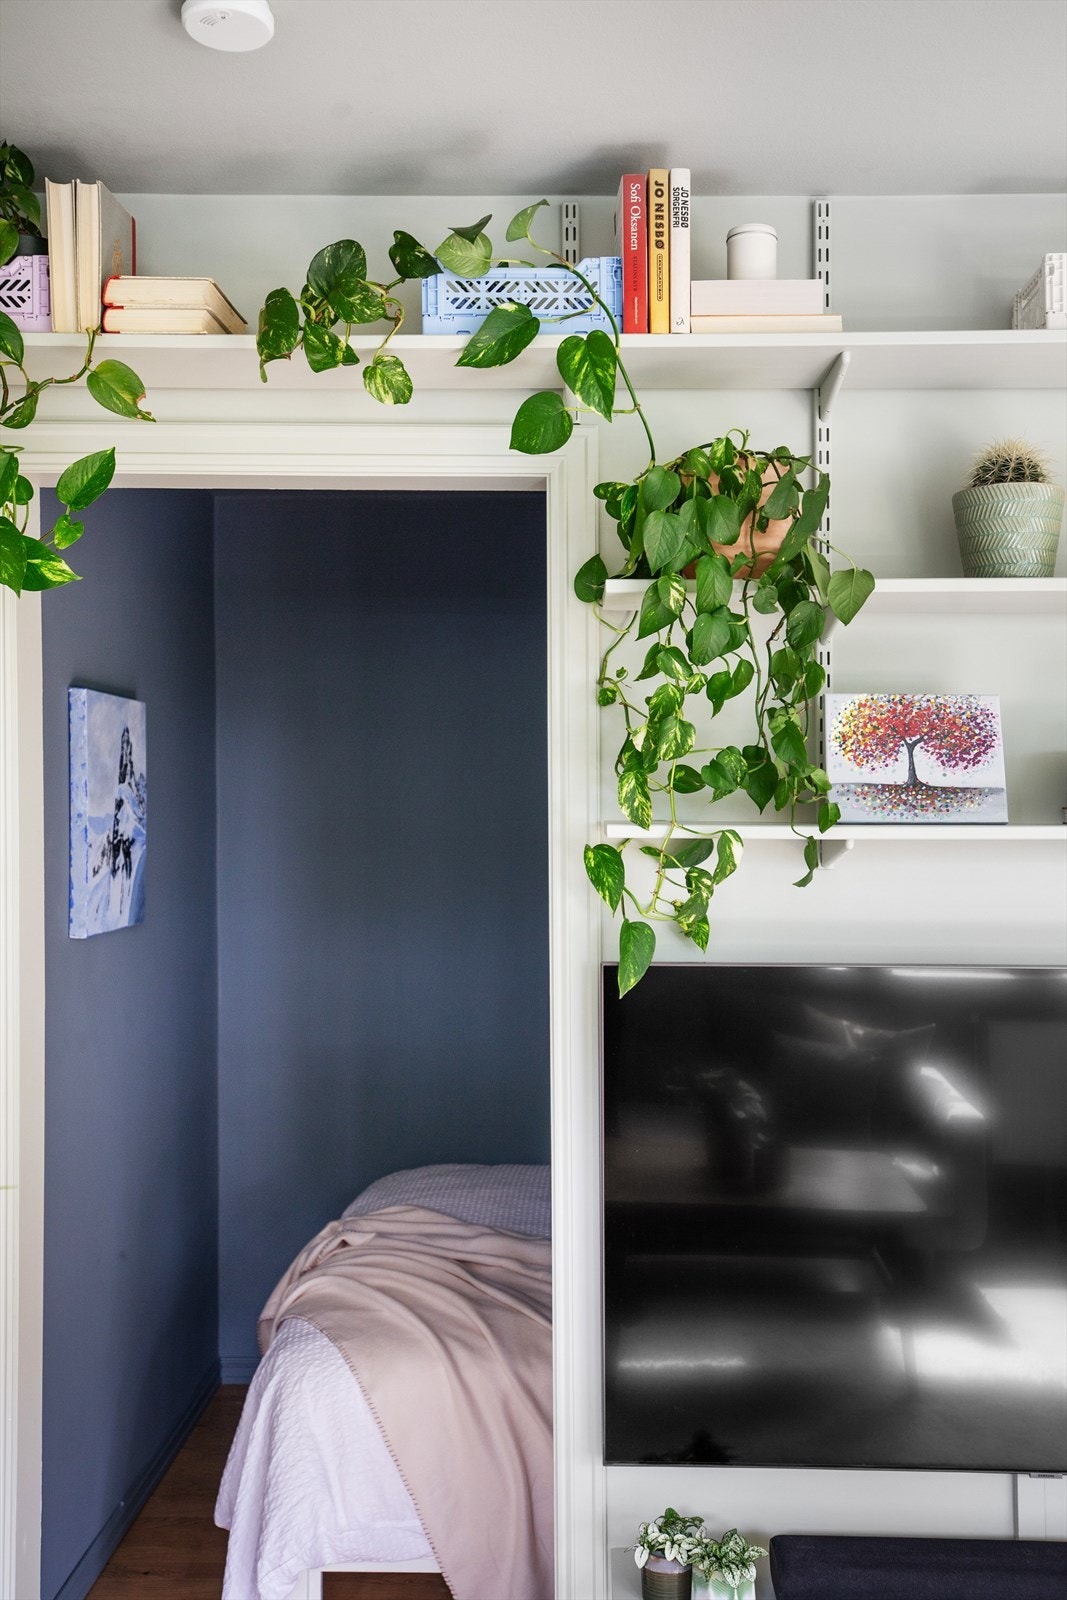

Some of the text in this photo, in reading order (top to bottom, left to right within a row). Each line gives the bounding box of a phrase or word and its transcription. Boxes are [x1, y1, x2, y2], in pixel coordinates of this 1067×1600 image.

[630, 182, 641, 251] Sofi Oksanen
[654, 180, 665, 250] JO NESBØ
[672, 187, 680, 228] SORGENFRI
[680, 187, 689, 229] JO NESBØ
